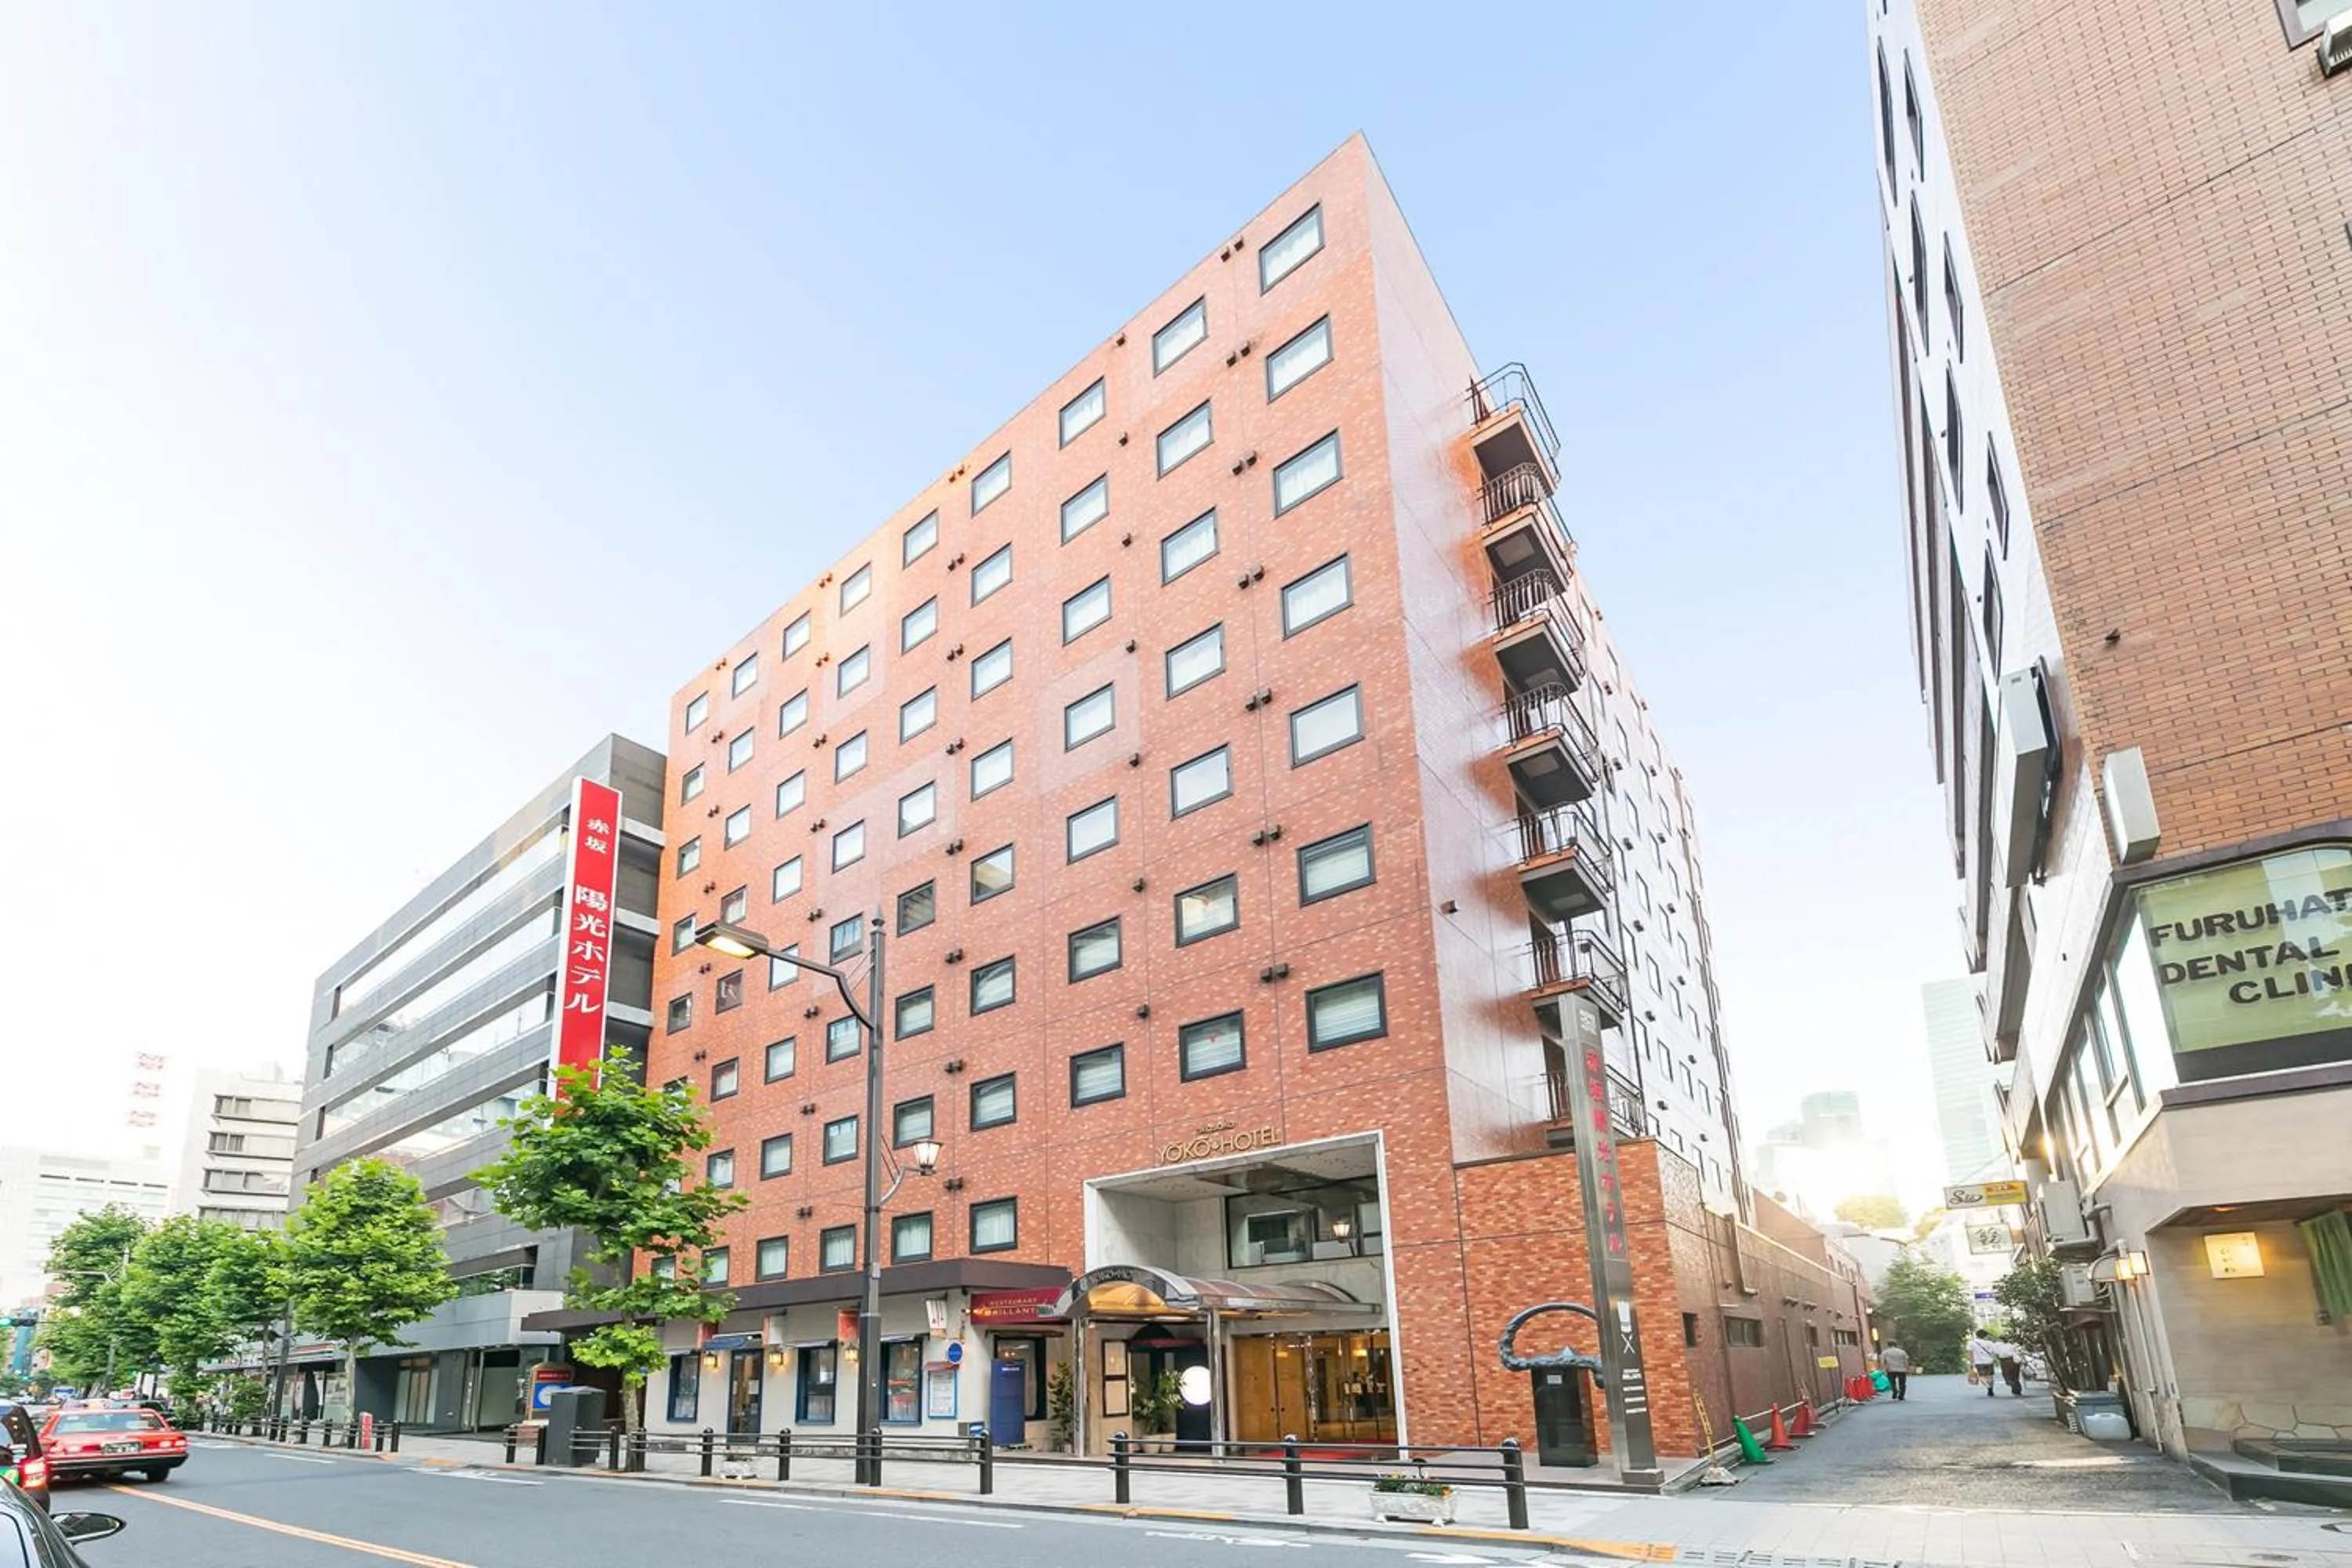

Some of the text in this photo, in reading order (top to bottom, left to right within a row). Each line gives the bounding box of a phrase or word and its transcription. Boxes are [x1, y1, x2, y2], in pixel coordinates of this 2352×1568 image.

[564, 818, 610, 1014] 赤坂 陽光ホテル
[2158, 936, 2340, 985] DENTAL
